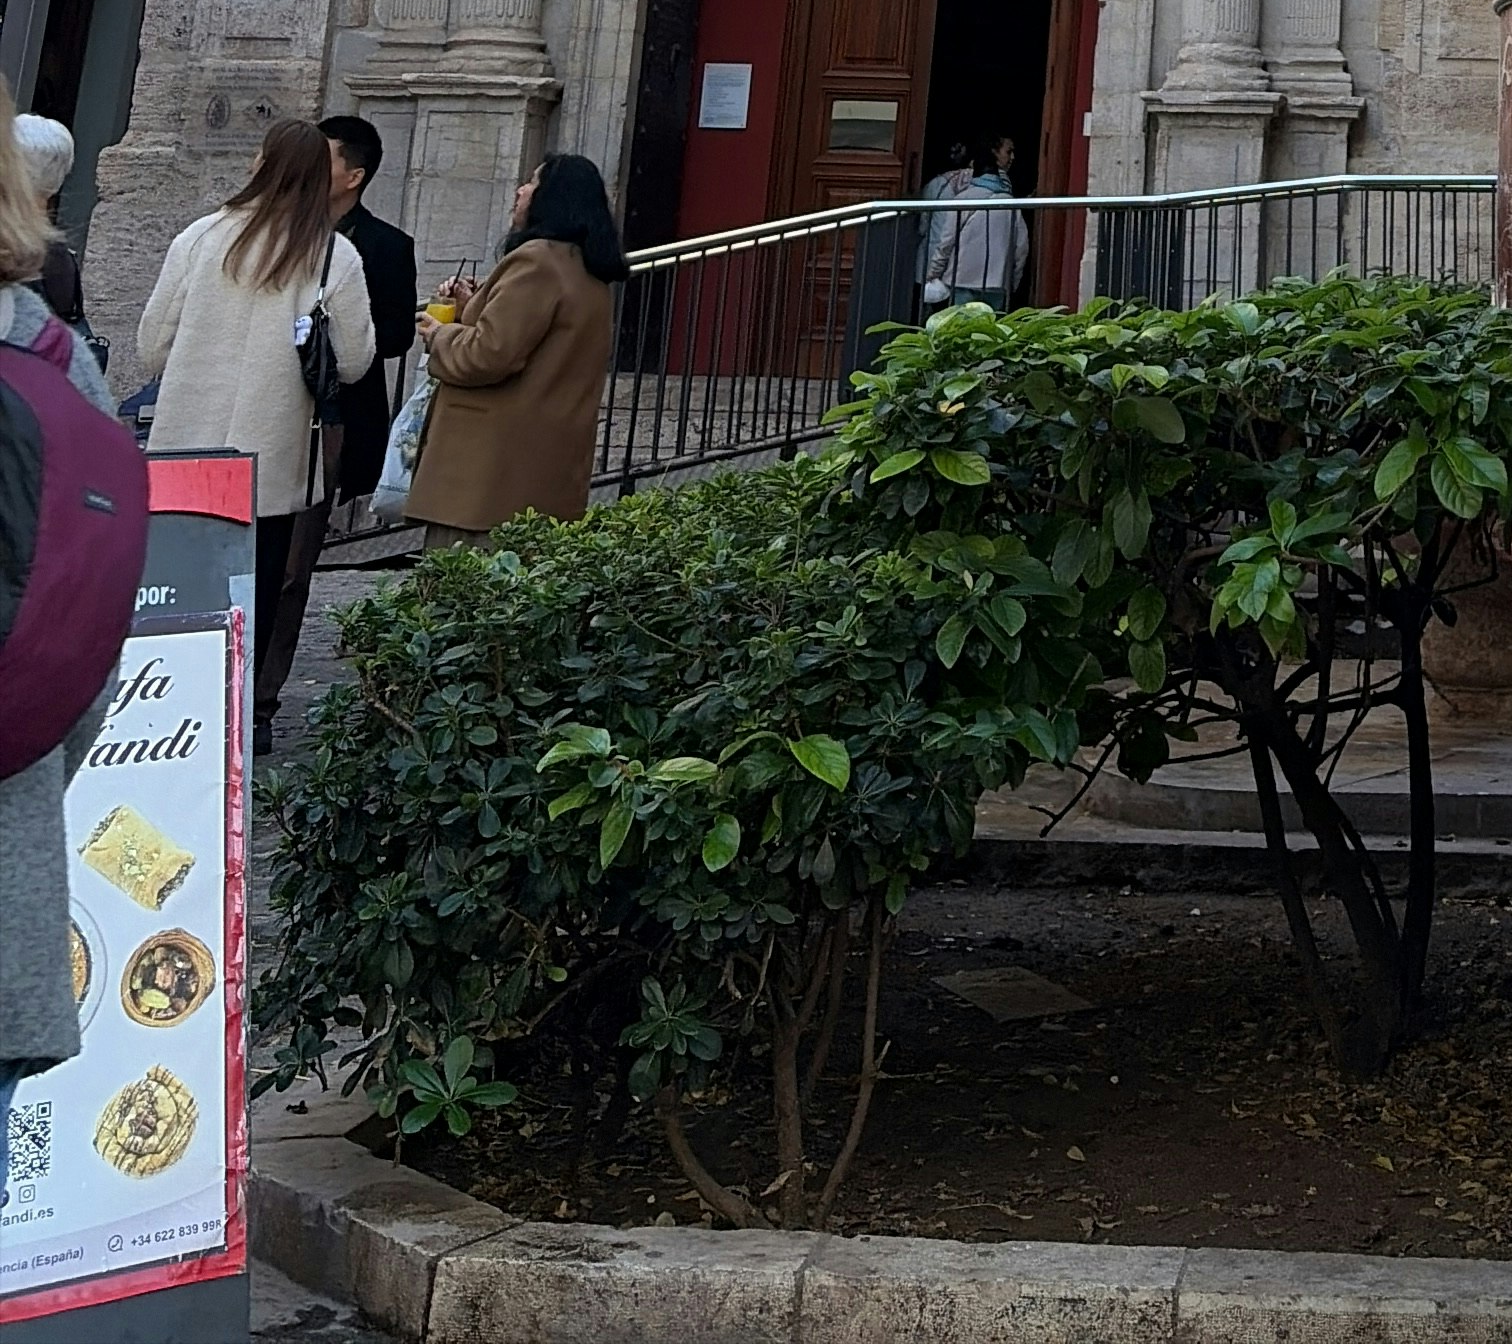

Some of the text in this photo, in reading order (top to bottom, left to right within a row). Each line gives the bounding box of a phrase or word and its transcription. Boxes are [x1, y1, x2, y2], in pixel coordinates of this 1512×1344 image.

[0, 1207, 55, 1227] andi.es
[131, 1233, 151, 1247] +34
[154, 1228, 175, 1243] 622
[178, 1223, 199, 1238] 839
[31, 1246, 84, 1270] (España)
